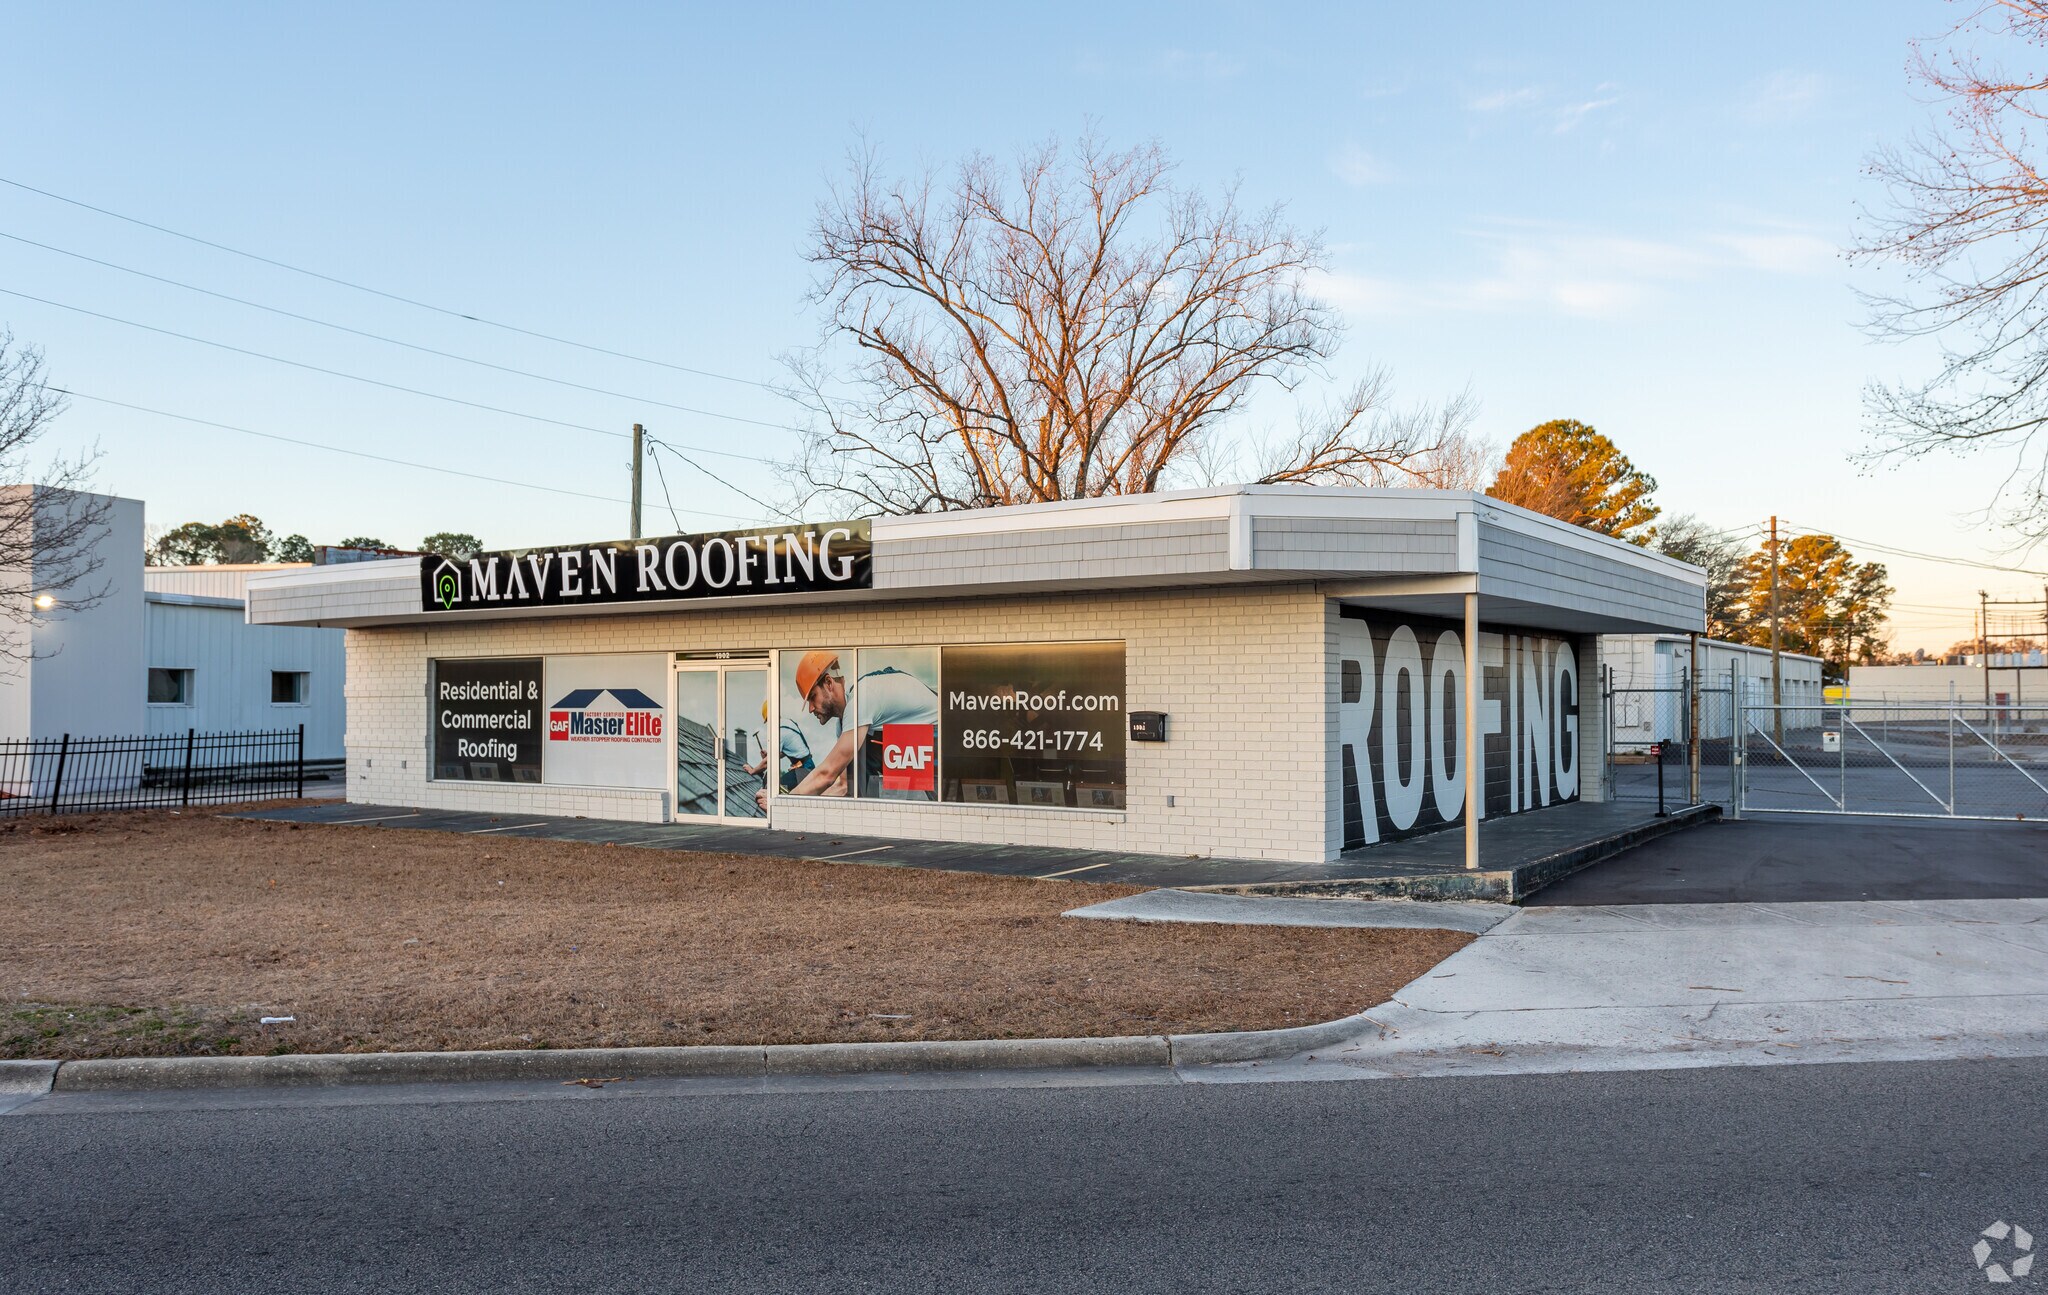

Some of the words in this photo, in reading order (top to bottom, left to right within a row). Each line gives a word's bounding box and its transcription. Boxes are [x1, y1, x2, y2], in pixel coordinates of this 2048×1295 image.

[469, 548, 618, 602] MAVEN
[635, 528, 855, 592] ROOFING
[440, 680, 523, 700] Residential
[527, 680, 538, 700] &
[949, 690, 1119, 711] MavenRoof.com
[441, 709, 531, 730] Commercial
[550, 720, 568, 732] GAF
[570, 711, 624, 735] Master
[962, 729, 1104, 751] 866-421-1774
[1340, 617, 1579, 849] ROOFING
[458, 738, 518, 762] Roofing
[883, 744, 934, 770] GAF
